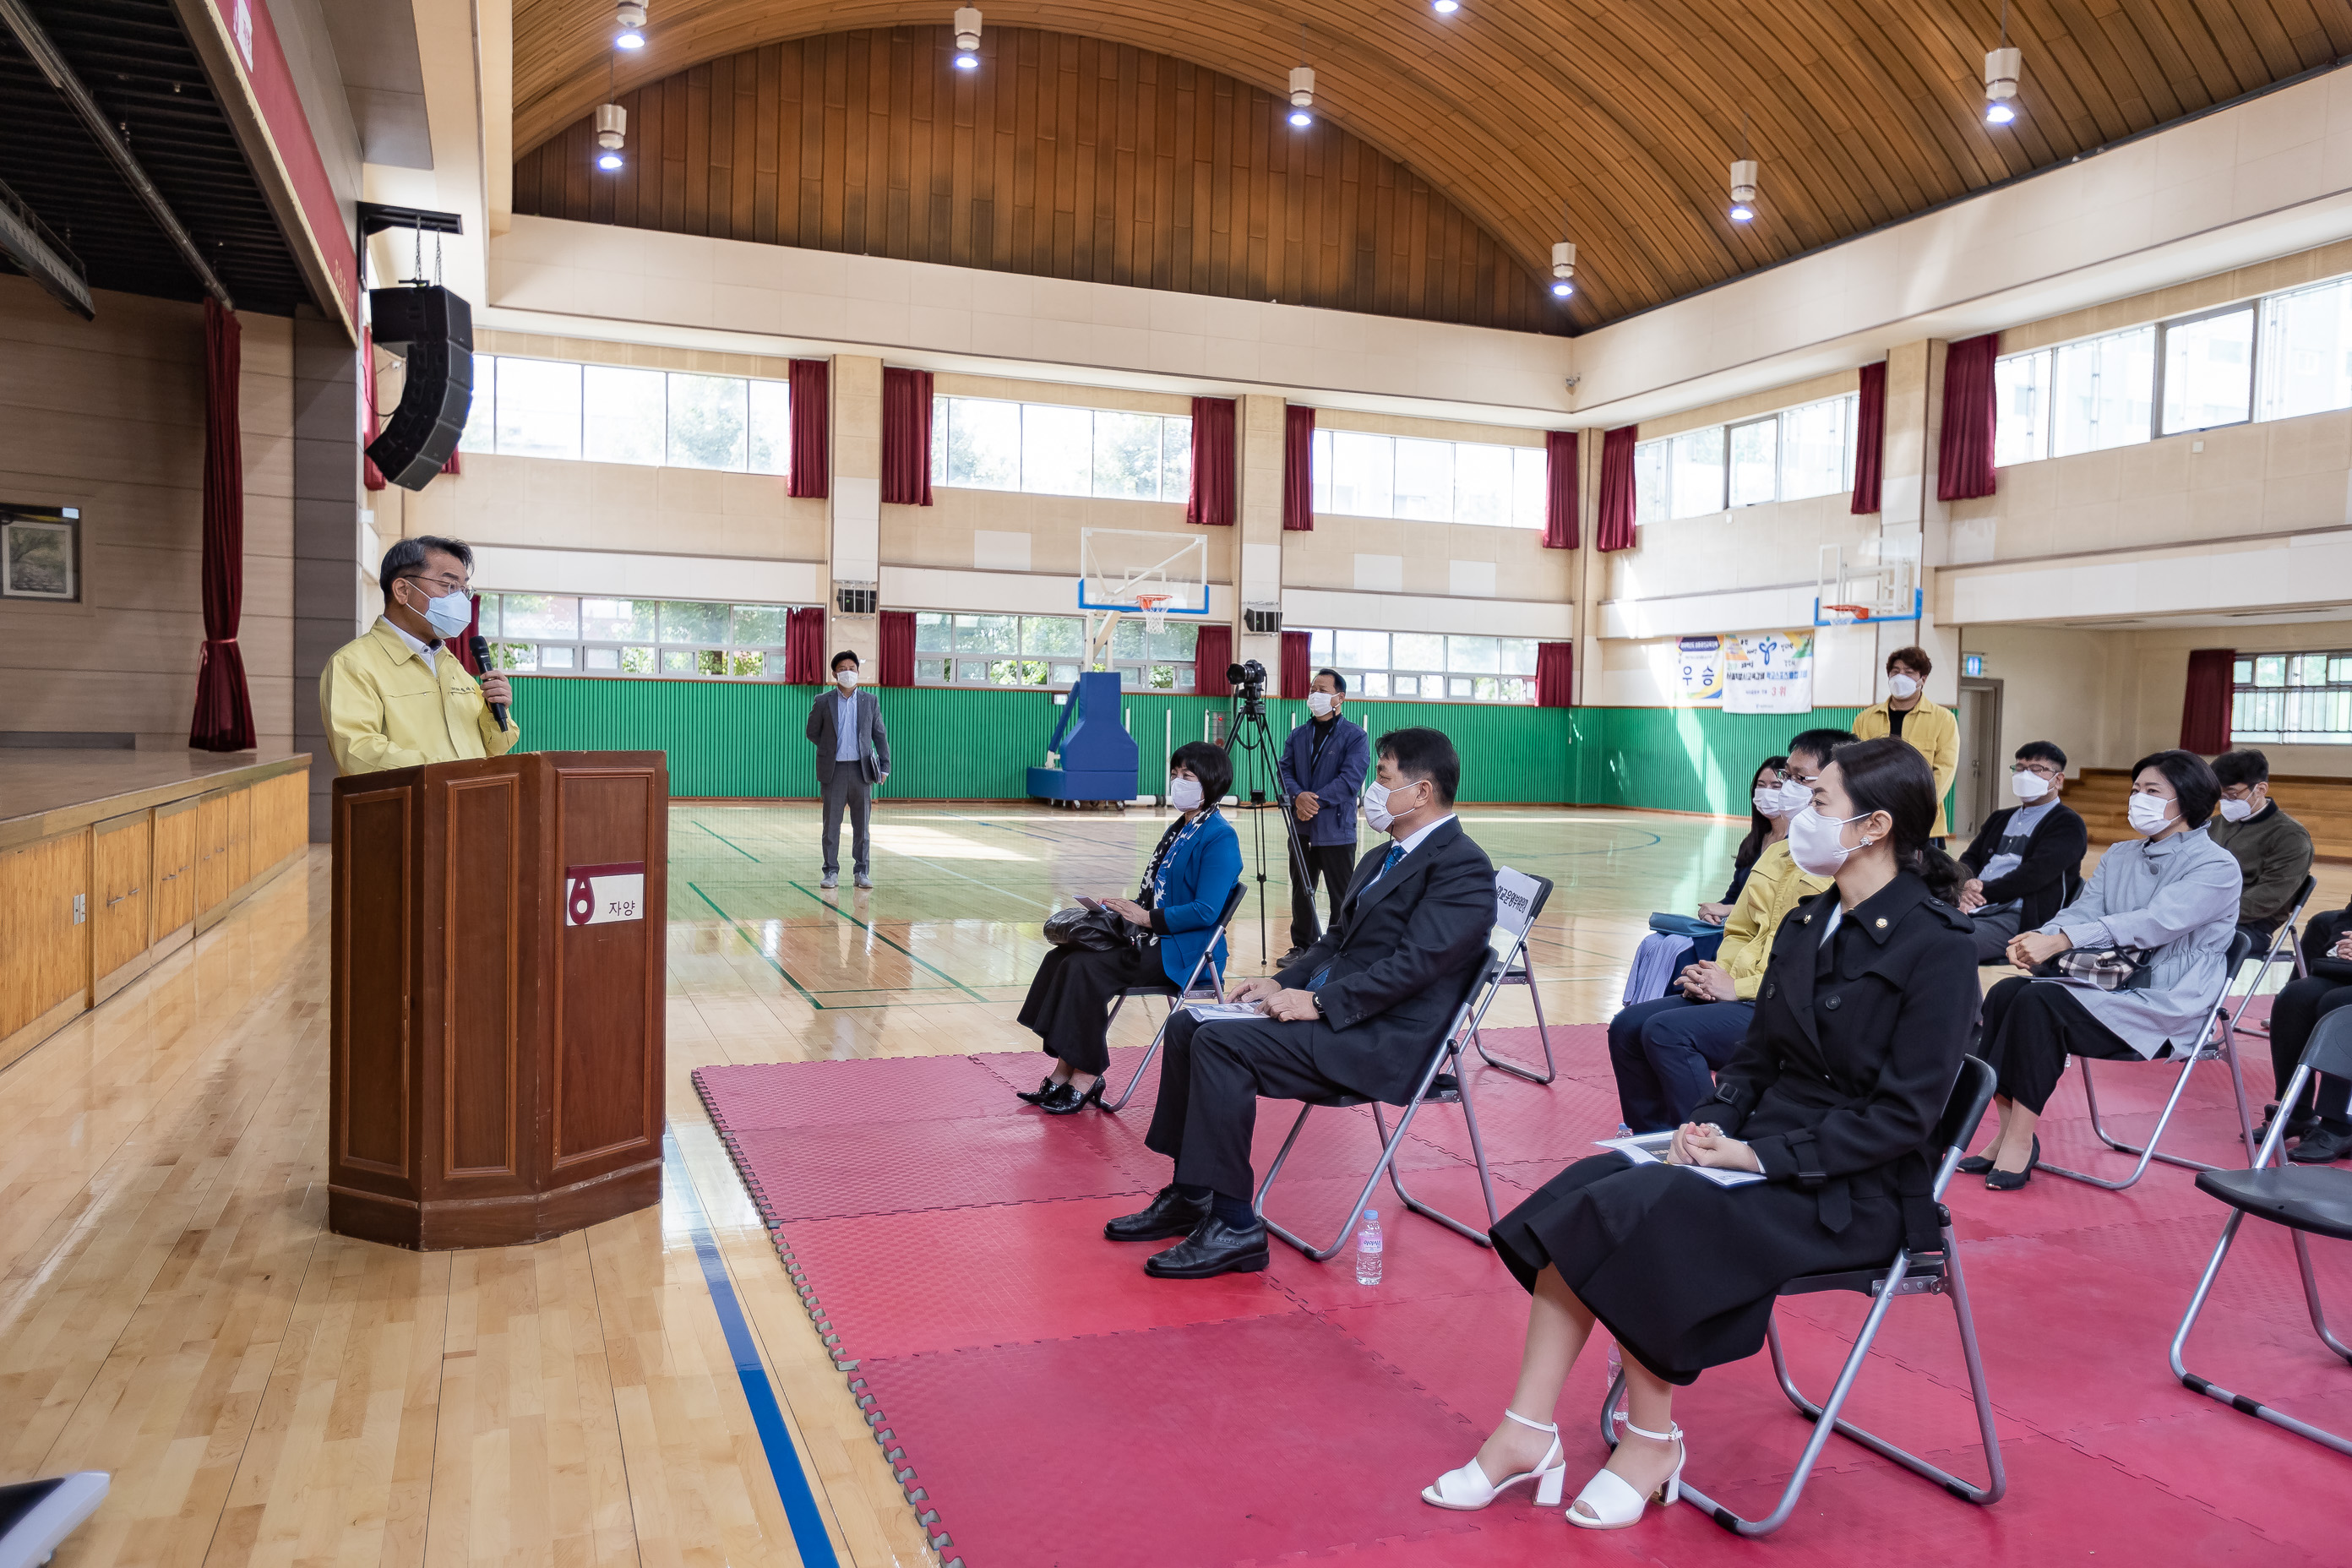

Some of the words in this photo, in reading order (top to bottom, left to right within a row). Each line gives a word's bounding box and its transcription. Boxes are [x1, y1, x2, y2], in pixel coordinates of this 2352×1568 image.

[1683, 666, 1692, 686] 우
[1701, 666, 1714, 686] 승
[1772, 686, 1777, 697] 3
[1779, 685, 1787, 697] 위
[608, 900, 636, 917] 자양
